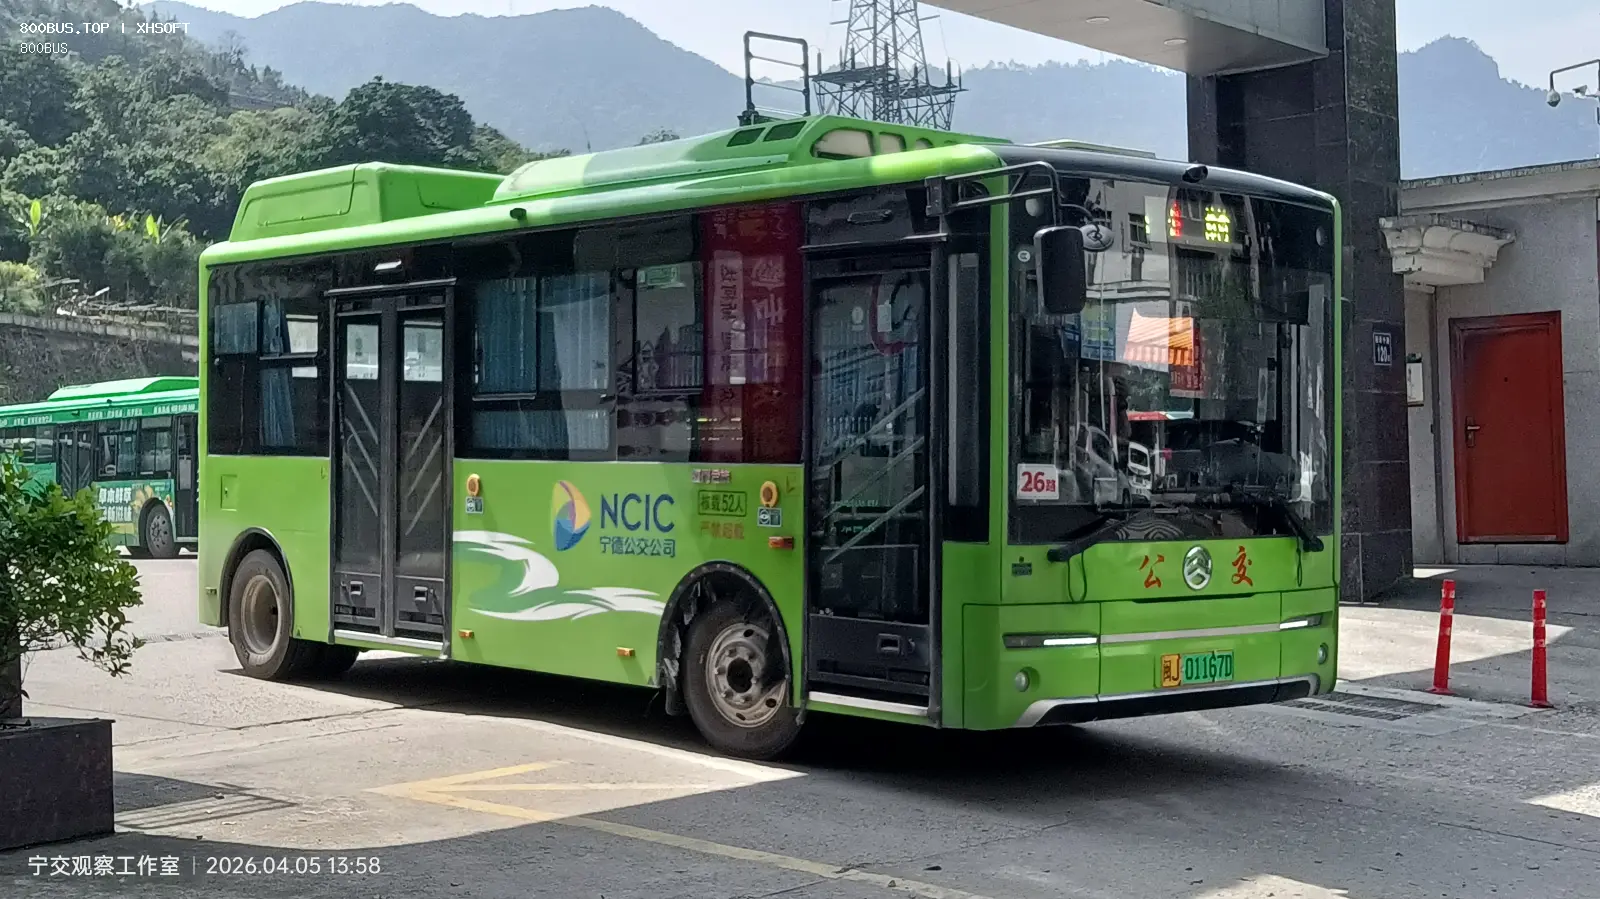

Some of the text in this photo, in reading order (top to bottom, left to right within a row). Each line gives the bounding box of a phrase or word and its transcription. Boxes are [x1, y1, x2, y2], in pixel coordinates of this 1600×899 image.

[1021, 471, 1056, 492] 26路
[600, 493, 675, 533] NCIC
[700, 493, 744, 513] 核载52人
[600, 536, 676, 558] 宁德公交公司
[1139, 545, 1253, 589] 公 交
[1184, 654, 1233, 681] 01167D
